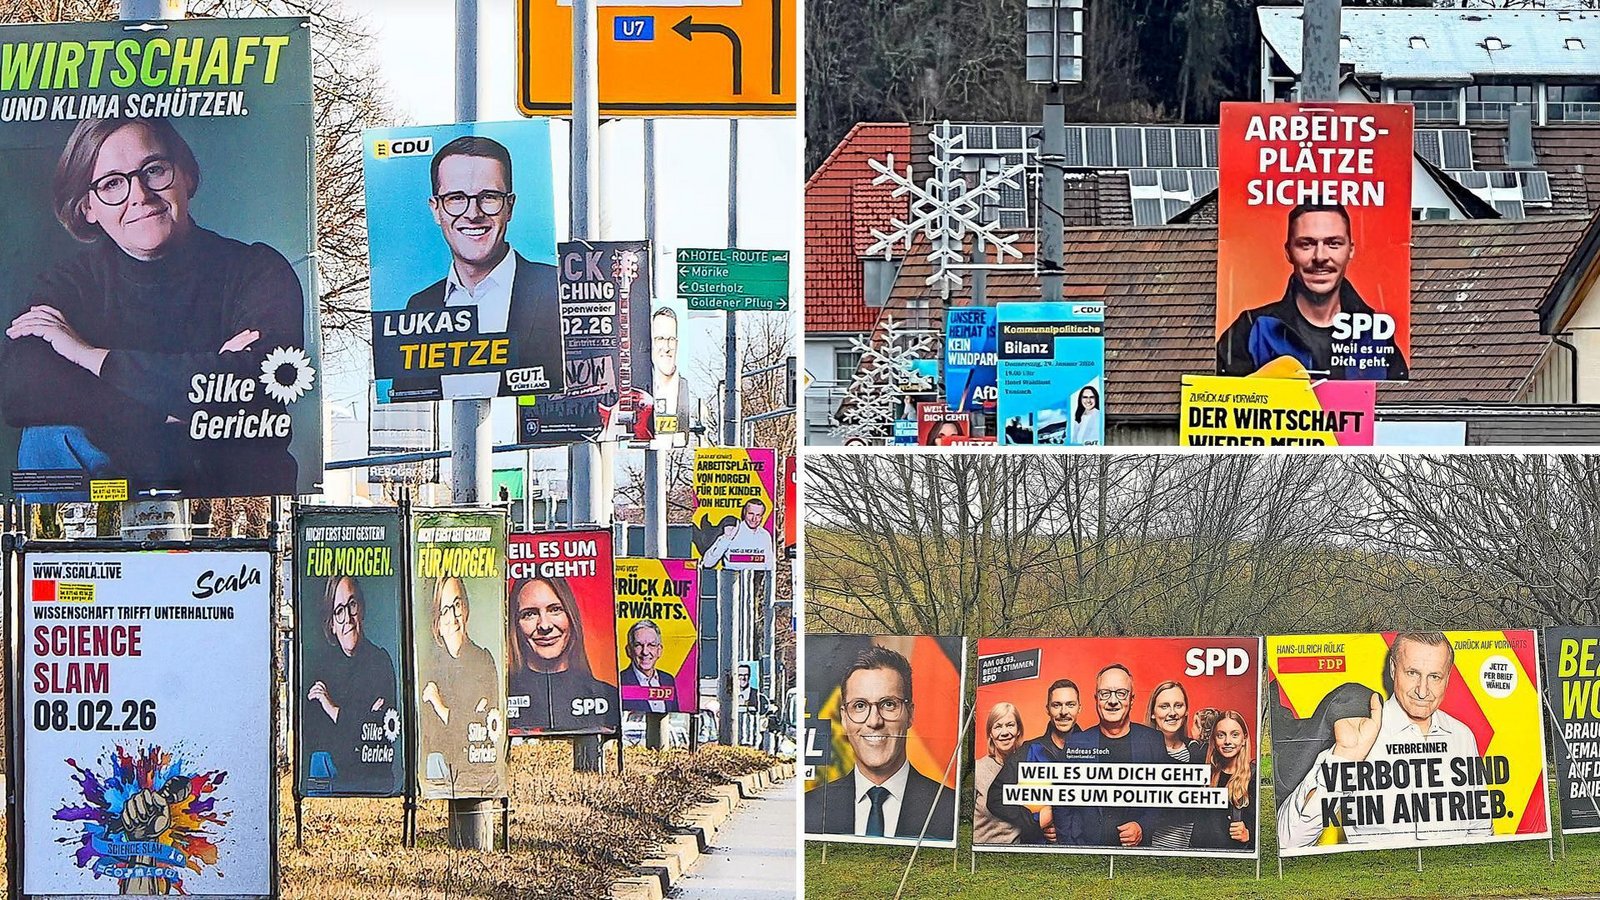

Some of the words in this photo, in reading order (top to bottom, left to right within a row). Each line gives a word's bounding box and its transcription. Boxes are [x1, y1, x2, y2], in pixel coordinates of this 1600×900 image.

[622, 21, 644, 36] U7
[0, 36, 290, 91] WIRTSCHAFT
[1, 96, 47, 121] UND
[50, 94, 120, 120] KLIMA
[124, 88, 249, 118] SCHÜTZEN.
[1245, 115, 1389, 142] ARBEITS-
[391, 140, 430, 155] CDU
[1259, 141, 1374, 174] PLÄTZE
[1247, 179, 1385, 206] SICHERN
[691, 251, 769, 262] HOTEL-ROUTE
[691, 266, 729, 277] Mörike
[691, 282, 743, 293] Osterholz
[691, 297, 741, 307] Goldener
[744, 298, 773, 309] Pflug
[383, 310, 472, 336] LUKAS
[951, 312, 986, 324] UNSERE
[949, 326, 984, 338] HEIMAT
[1004, 325, 1101, 334] Kommunalpolitische
[1331, 313, 1396, 340] SPD
[948, 339, 971, 351] KEIN
[1005, 341, 1049, 354] Bilanz
[1331, 343, 1355, 354] Weil
[1360, 346, 1374, 354] es
[1377, 346, 1395, 354] um
[400, 339, 510, 370] TIETZE
[1331, 356, 1356, 367] Dich
[1359, 356, 1389, 369] geht.
[510, 369, 542, 383] GUT.
[188, 373, 256, 404] Silke
[972, 386, 998, 400] AfD
[189, 408, 292, 440] Gericke
[1189, 407, 1227, 428] DER
[1234, 408, 1364, 432] WIRTSCHAFT
[697, 459, 765, 472] ARBEITSPLÄTZE
[697, 473, 713, 483] VON
[715, 474, 750, 483] MORGEN
[696, 483, 711, 496] FÜR
[714, 486, 727, 495] DIE
[729, 486, 761, 496] KINDER
[325, 527, 342, 541] ERST
[341, 527, 356, 540] SEIT
[356, 526, 386, 540] GESTERN
[538, 542, 561, 558] ES
[564, 541, 597, 557] UM
[306, 542, 333, 576] FÜR
[334, 547, 394, 576] MORGEN.
[417, 542, 442, 578] FÜR
[441, 547, 499, 578] MORGEN.
[33, 566, 122, 579] WWW.SCALA.LIVE
[540, 559, 596, 577] GEHT!
[192, 564, 261, 599] Scala
[662, 579, 692, 597] AUF
[33, 606, 114, 620] WISSENSCHAFT
[117, 606, 151, 620] TRIFFT
[154, 606, 234, 620] UNTERHALTUNG
[617, 597, 687, 620] RWÄRTS.
[33, 625, 142, 657] SCIENCE
[1276, 645, 1322, 654] HANS-ULRICH
[1323, 643, 1345, 653] RÜLKE
[1454, 640, 1479, 650] ZURÜCK
[1481, 641, 1493, 649] AUF
[1494, 639, 1528, 648] VORWÄRTS
[1184, 648, 1249, 676] SPD
[1318, 659, 1343, 669] FDP
[1558, 638, 1600, 677] BE
[983, 666, 1002, 675] BEIDE
[1003, 660, 1035, 672] STIMMEN
[1489, 663, 1508, 671] JETZT
[33, 662, 109, 693] SLAM
[983, 675, 996, 683] SPD
[1486, 680, 1511, 691] WÄHLEN
[649, 689, 672, 699] FDP
[33, 699, 157, 731] 08.02.26
[571, 700, 608, 716] SPD
[362, 724, 382, 740] Silke
[1565, 722, 1600, 740] BRAU
[362, 744, 393, 762] Gericke
[1386, 742, 1448, 755] VERBRENNER
[1566, 742, 1600, 760] JEMA
[1021, 766, 1058, 779] WEIL
[1063, 767, 1081, 779] ES
[1086, 767, 1113, 780] UM
[1118, 768, 1156, 780] DICH
[1159, 769, 1208, 784] GEHT,
[1321, 757, 1443, 793] VERBOTE
[1450, 755, 1510, 785] SIND
[1568, 762, 1592, 779] AUF
[1005, 788, 1053, 802] WENN
[1058, 789, 1075, 802] ES
[1081, 789, 1108, 803] UM
[1113, 790, 1173, 804] POLITIK
[1178, 791, 1226, 805] GEHT.
[1321, 794, 1385, 827] KEIN
[1392, 789, 1514, 823] ANTRIEB.
